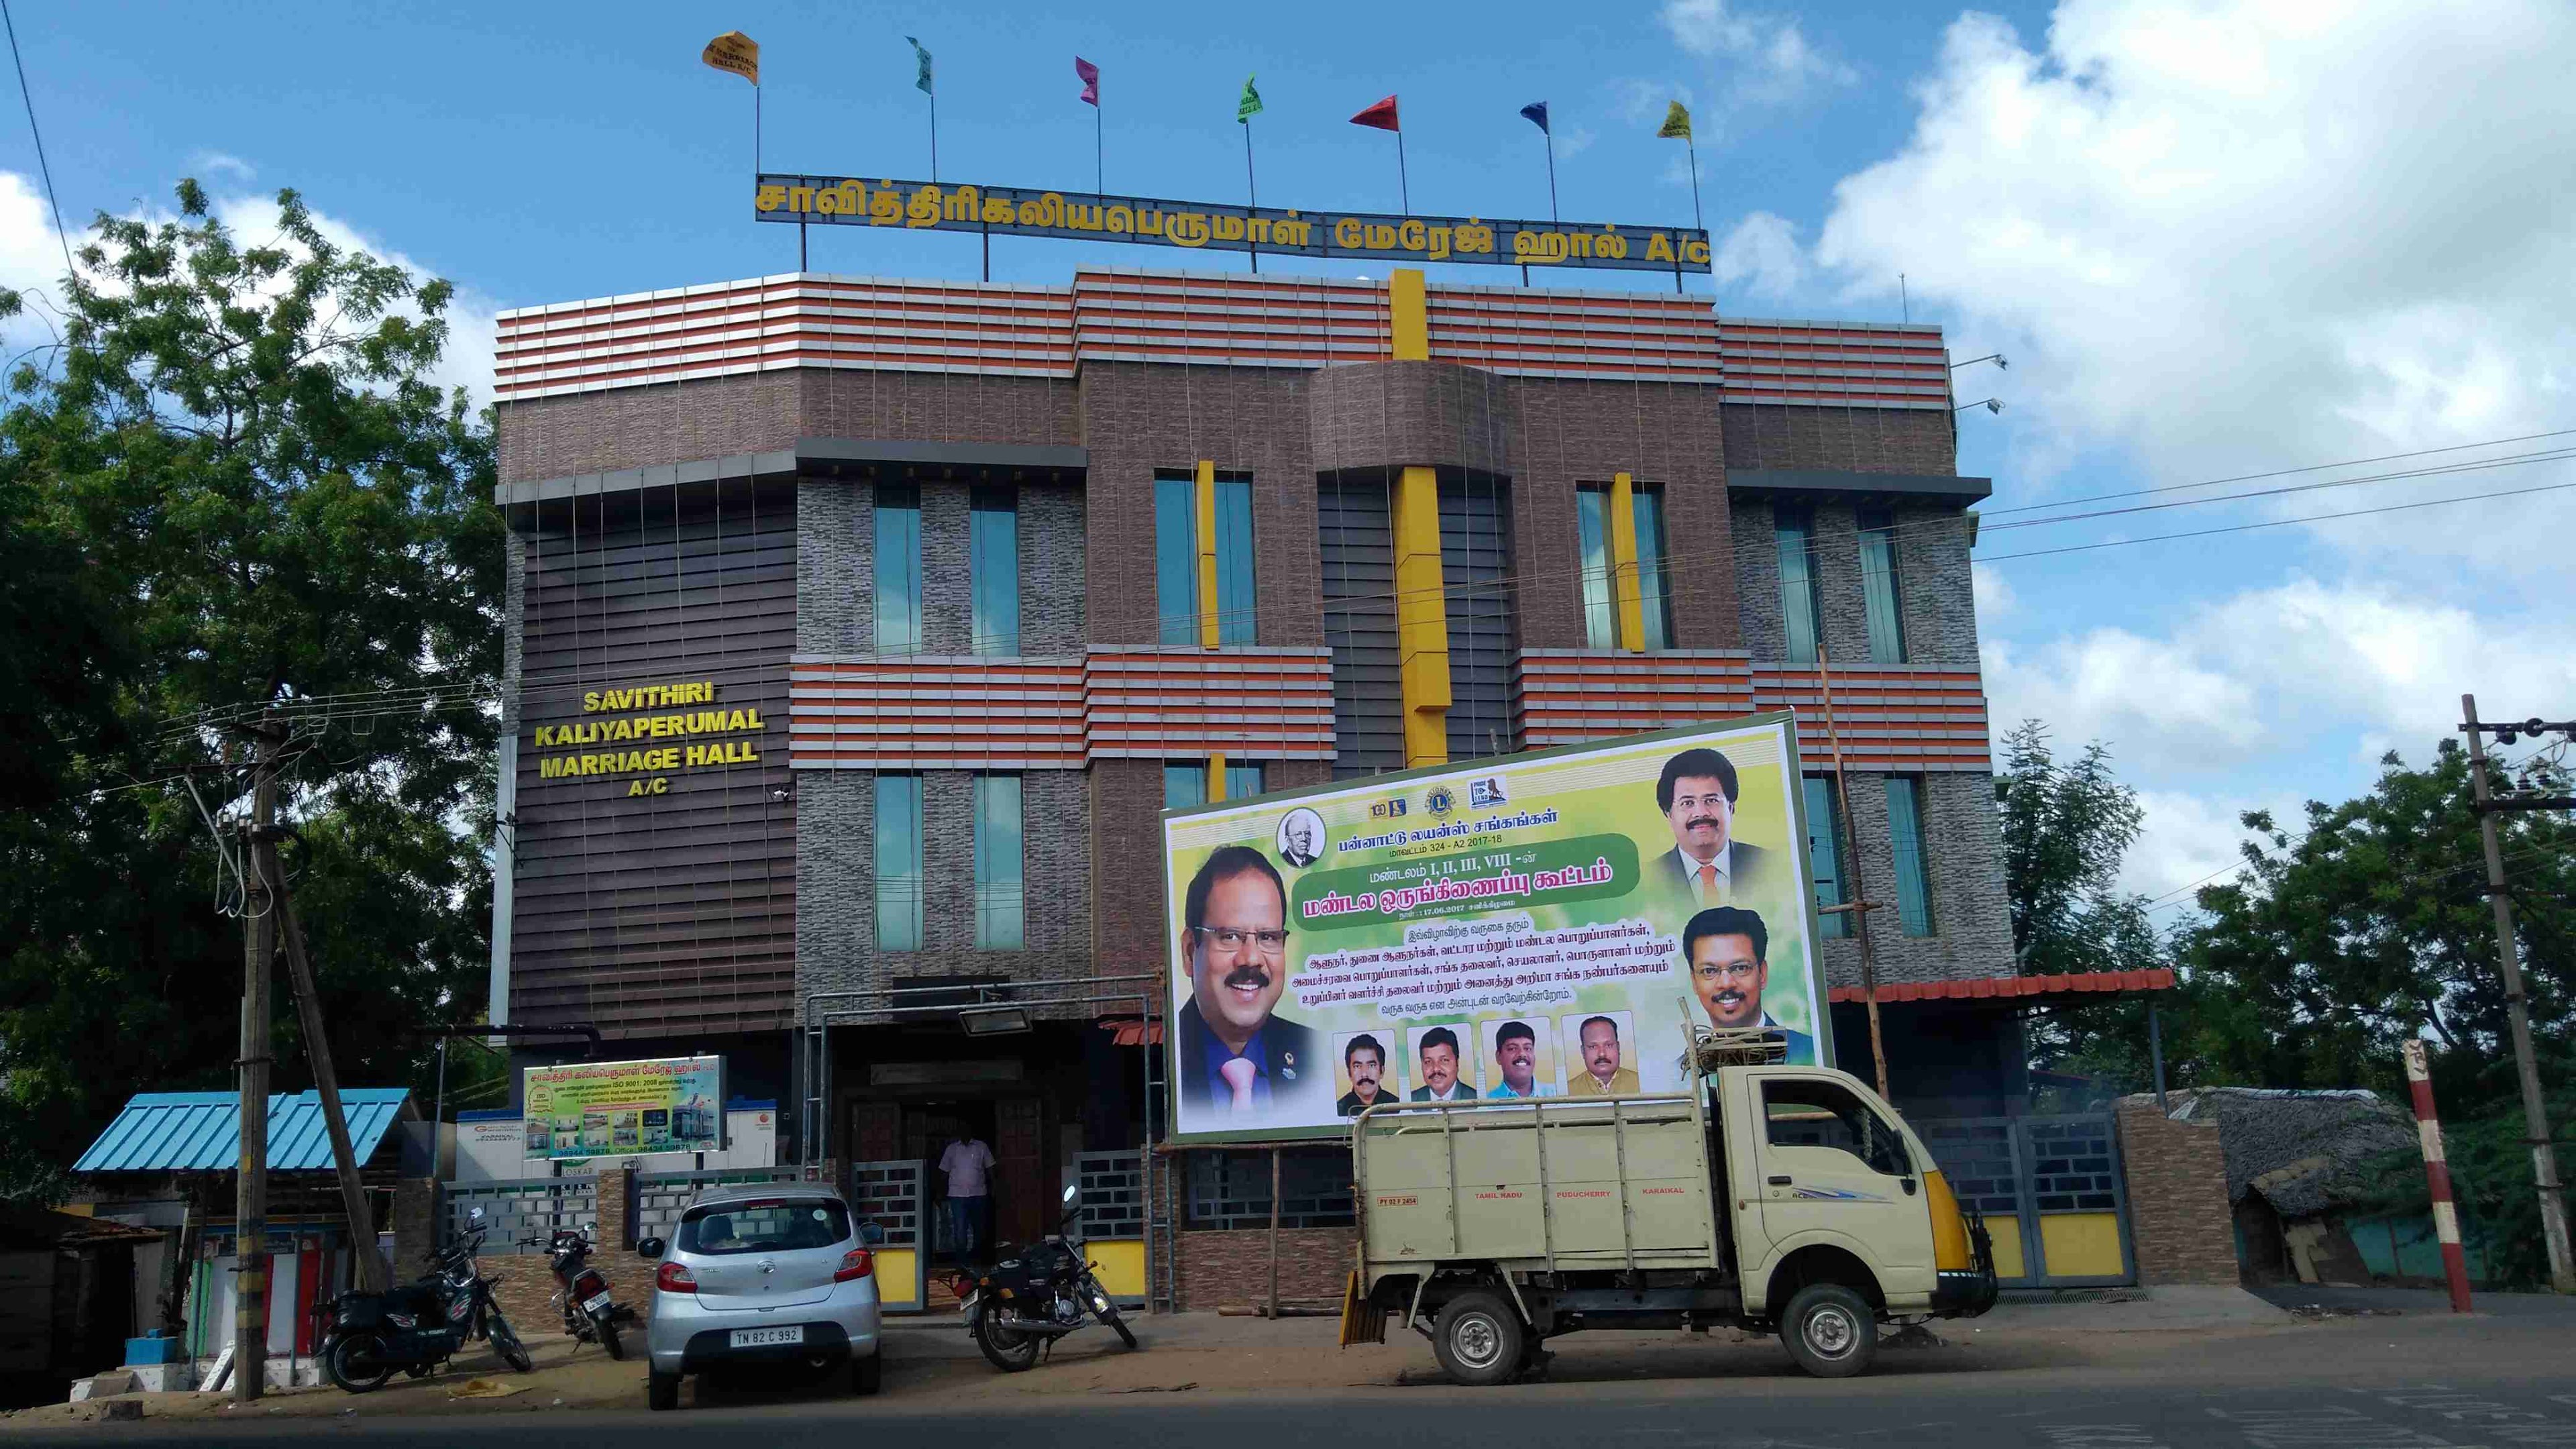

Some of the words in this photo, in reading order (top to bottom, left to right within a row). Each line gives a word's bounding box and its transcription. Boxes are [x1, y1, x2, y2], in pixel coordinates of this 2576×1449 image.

[1335, 215, 1493, 260] மேரேஜ்
[1512, 223, 1628, 265] ஹால்
[583, 680, 714, 712] SAVITHIRI
[534, 708, 765, 747] KALIYAPERUMAL
[539, 747, 681, 779] MARRIAGE
[685, 741, 759, 767] HALL
[628, 777, 669, 797] A/C
[1338, 830, 1407, 853] பன்னாட்டு
[1411, 820, 1470, 843] லயன்ஸ்
[1473, 808, 1558, 833] சங்கங்கள்
[1389, 844, 1428, 858] மாவட்டம்
[1430, 841, 1446, 853] 324
[1453, 839, 1465, 849] A2
[1466, 834, 1502, 847] 2017-18
[1370, 861, 1426, 883] மண்டலம்
[1430, 863, 1440, 877] I,
[1442, 859, 1458, 875] II,
[1460, 856, 1481, 873] III,
[1483, 853, 1511, 869] VIII
[1303, 890, 1375, 918] மண்டல
[1380, 869, 1529, 912] ஒருங்கிணைப்பு
[1534, 856, 1613, 890] கூட்டம்
[1408, 924, 1468, 943] இவ்விழாவிற்கு
[1470, 920, 1504, 936] வருகை
[1505, 917, 1529, 933] தரும்
[1309, 954, 1348, 970] ஆளுநர்,
[1349, 955, 1380, 968] துணை
[1382, 946, 1439, 962] ஆளுநர்கள்,
[1441, 943, 1474, 955] வட்டார
[1477, 936, 1513, 953] மற்றும்
[1515, 934, 1556, 949] மண்டல
[1557, 923, 1650, 945] பொறுப்பாளர்கள்,
[1291, 973, 1352, 988] அமைச்சரவை
[1352, 963, 1433, 984] பொறுப்பாளர்கள்,
[1434, 961, 1458, 975] சங்க
[1460, 956, 1504, 972] தலைவர்,
[1506, 949, 1564, 968] செயலாளர்,
[1566, 943, 1631, 963] பொருளாளர்
[1634, 939, 1676, 957] மற்றும்
[1301, 987, 1346, 1006] உறுப்பினர்
[1348, 985, 1385, 1001] வளர்ச்சி
[1385, 981, 1425, 998] தலைவர்
[1426, 977, 1462, 994] மற்றும்
[1464, 975, 1513, 989] அனைத்து
[1554, 967, 1581, 981] சங்க
[1582, 959, 1669, 981] நண்பர்களையும்
[1381, 1005, 1403, 1017] வருக
[1405, 1002, 1428, 1014] வருக
[1429, 1000, 1446, 1010] என
[1447, 994, 1490, 1012] அன்புடன்
[1491, 987, 1572, 1008] வரவேற்கின்றோம்.
[559, 1149, 584, 1157] 98944
[1556, 1190, 1611, 1199] PUDUCHERRY
[737, 1332, 749, 1344] TN
[753, 1332, 765, 1343] 82
[769, 1331, 775, 1342] C
[778, 1330, 797, 1342] 992
